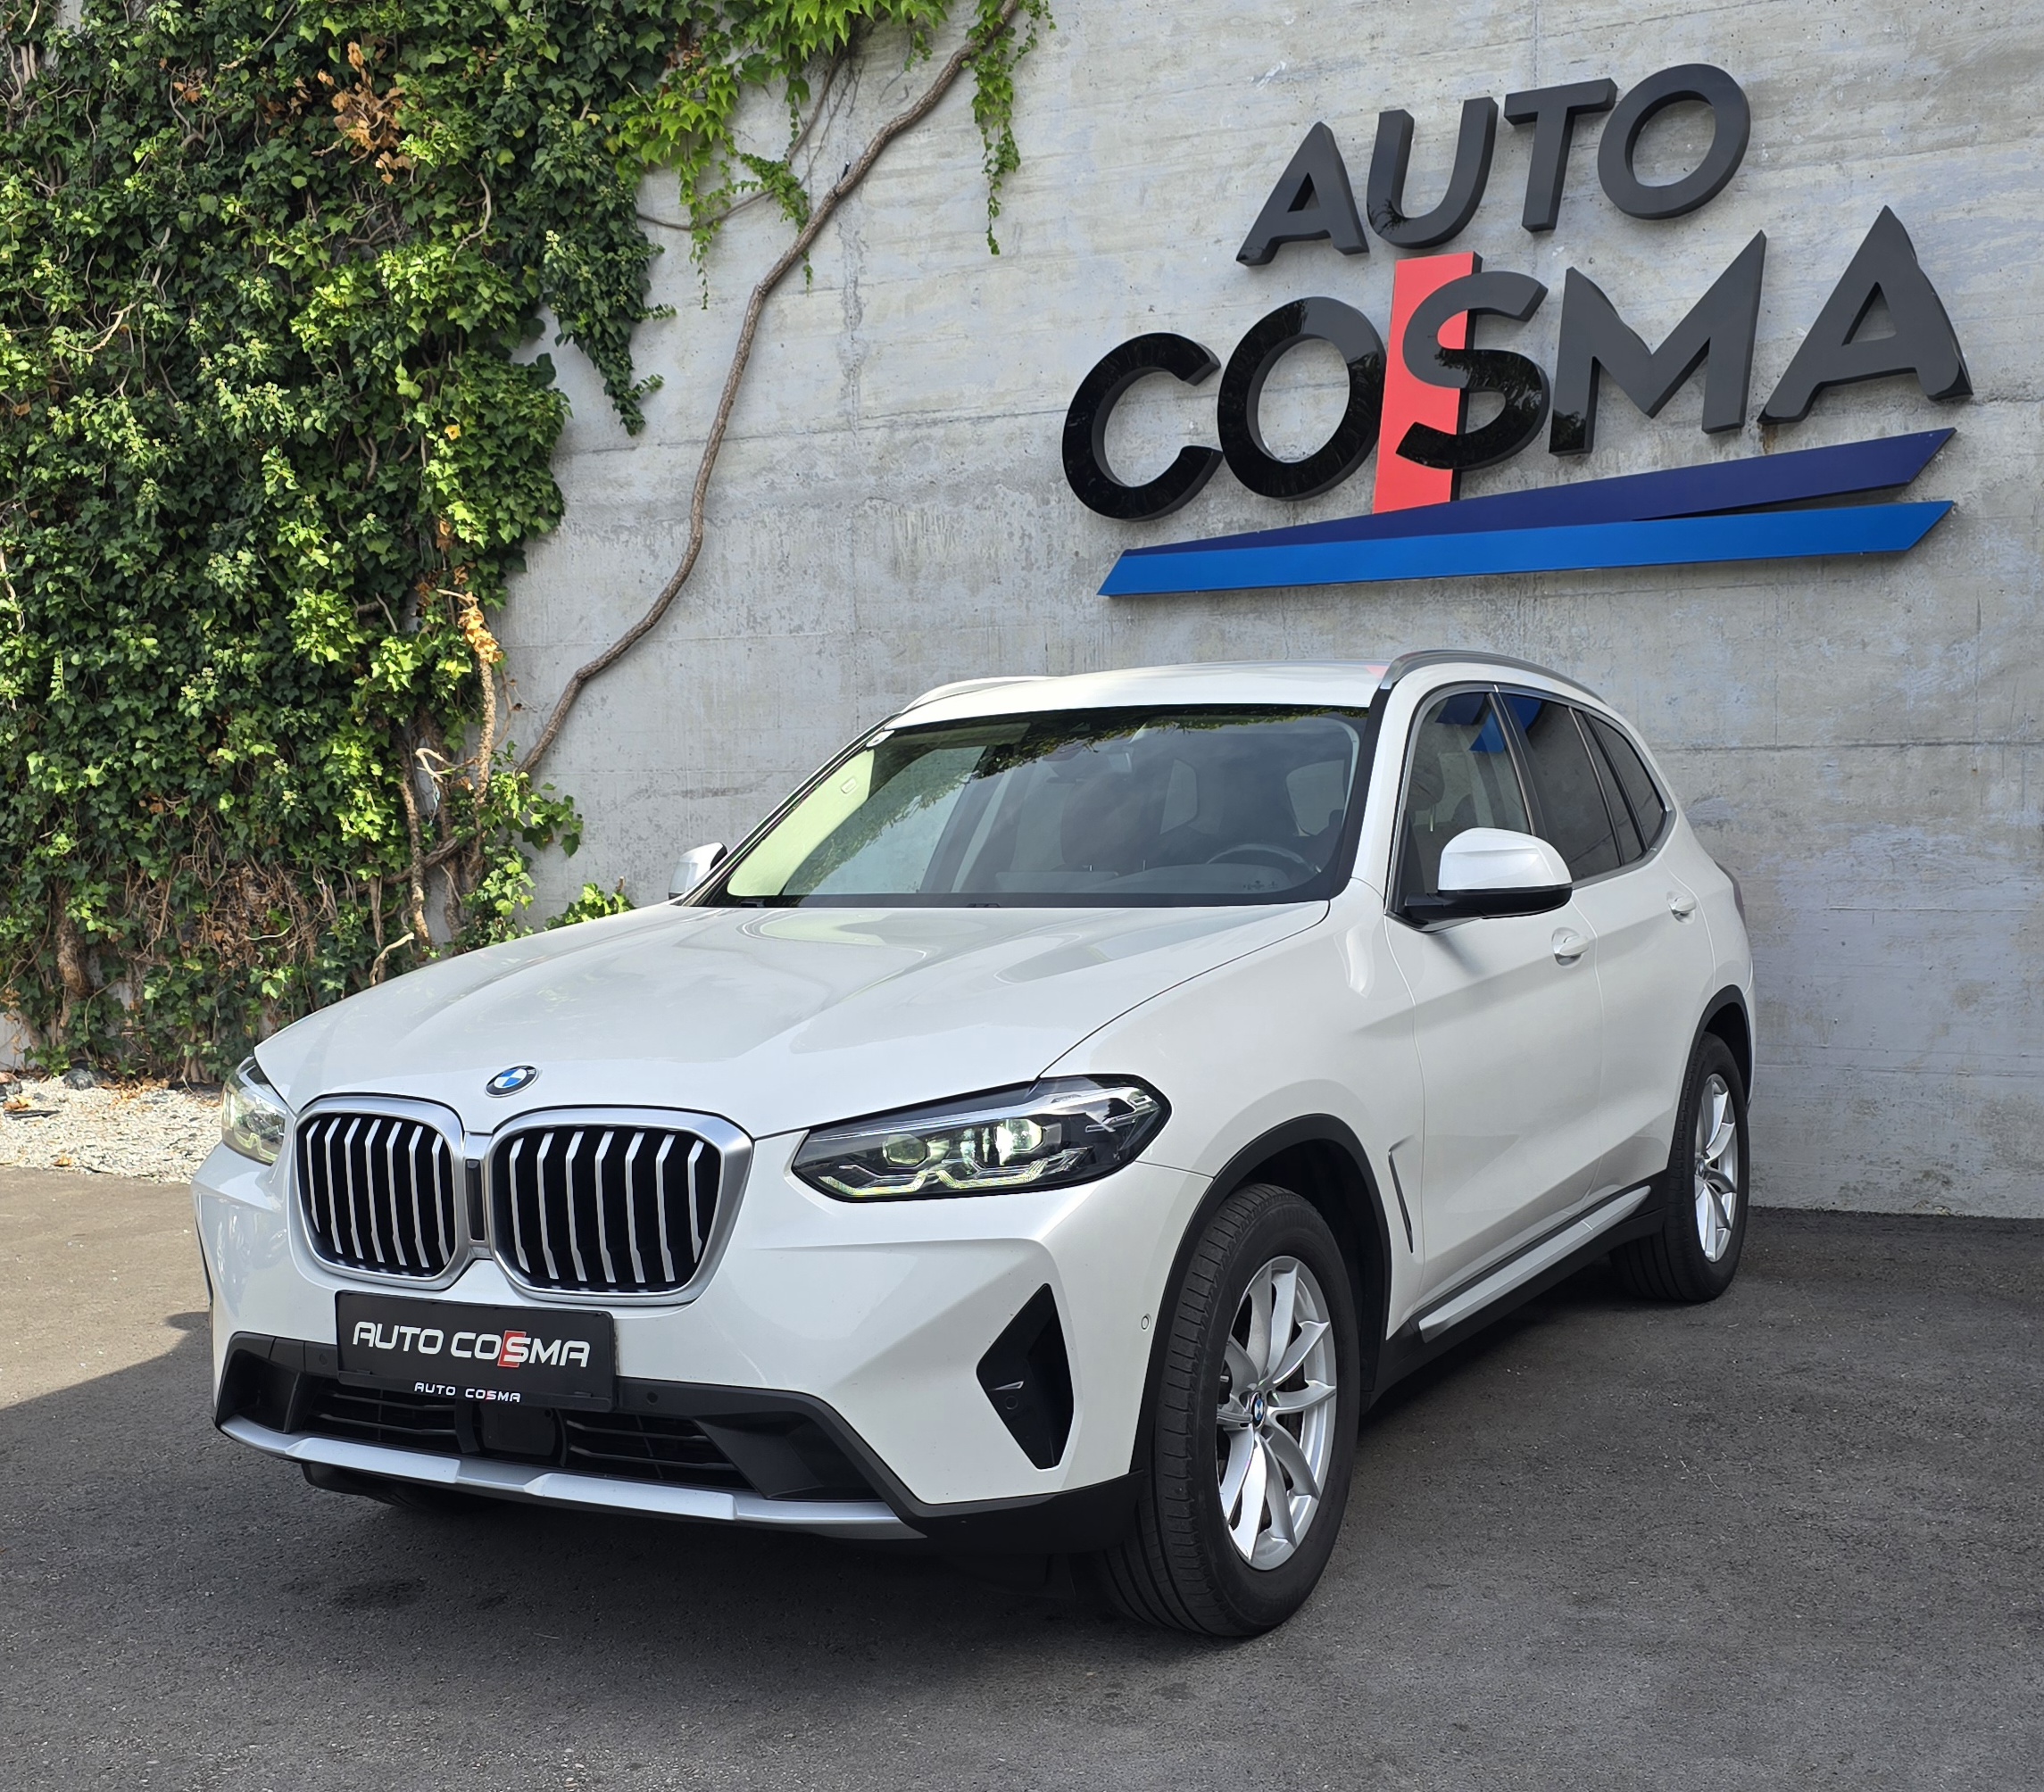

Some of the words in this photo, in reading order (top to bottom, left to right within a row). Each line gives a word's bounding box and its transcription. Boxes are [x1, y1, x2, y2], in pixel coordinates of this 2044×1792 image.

[1235, 63, 1750, 266] AUTO
[1062, 206, 1973, 520] COSMA
[353, 1321, 444, 1355] AUTO
[450, 1332, 591, 1367] COSMA
[414, 1382, 456, 1397] AUTO
[465, 1389, 521, 1403] COSMA
